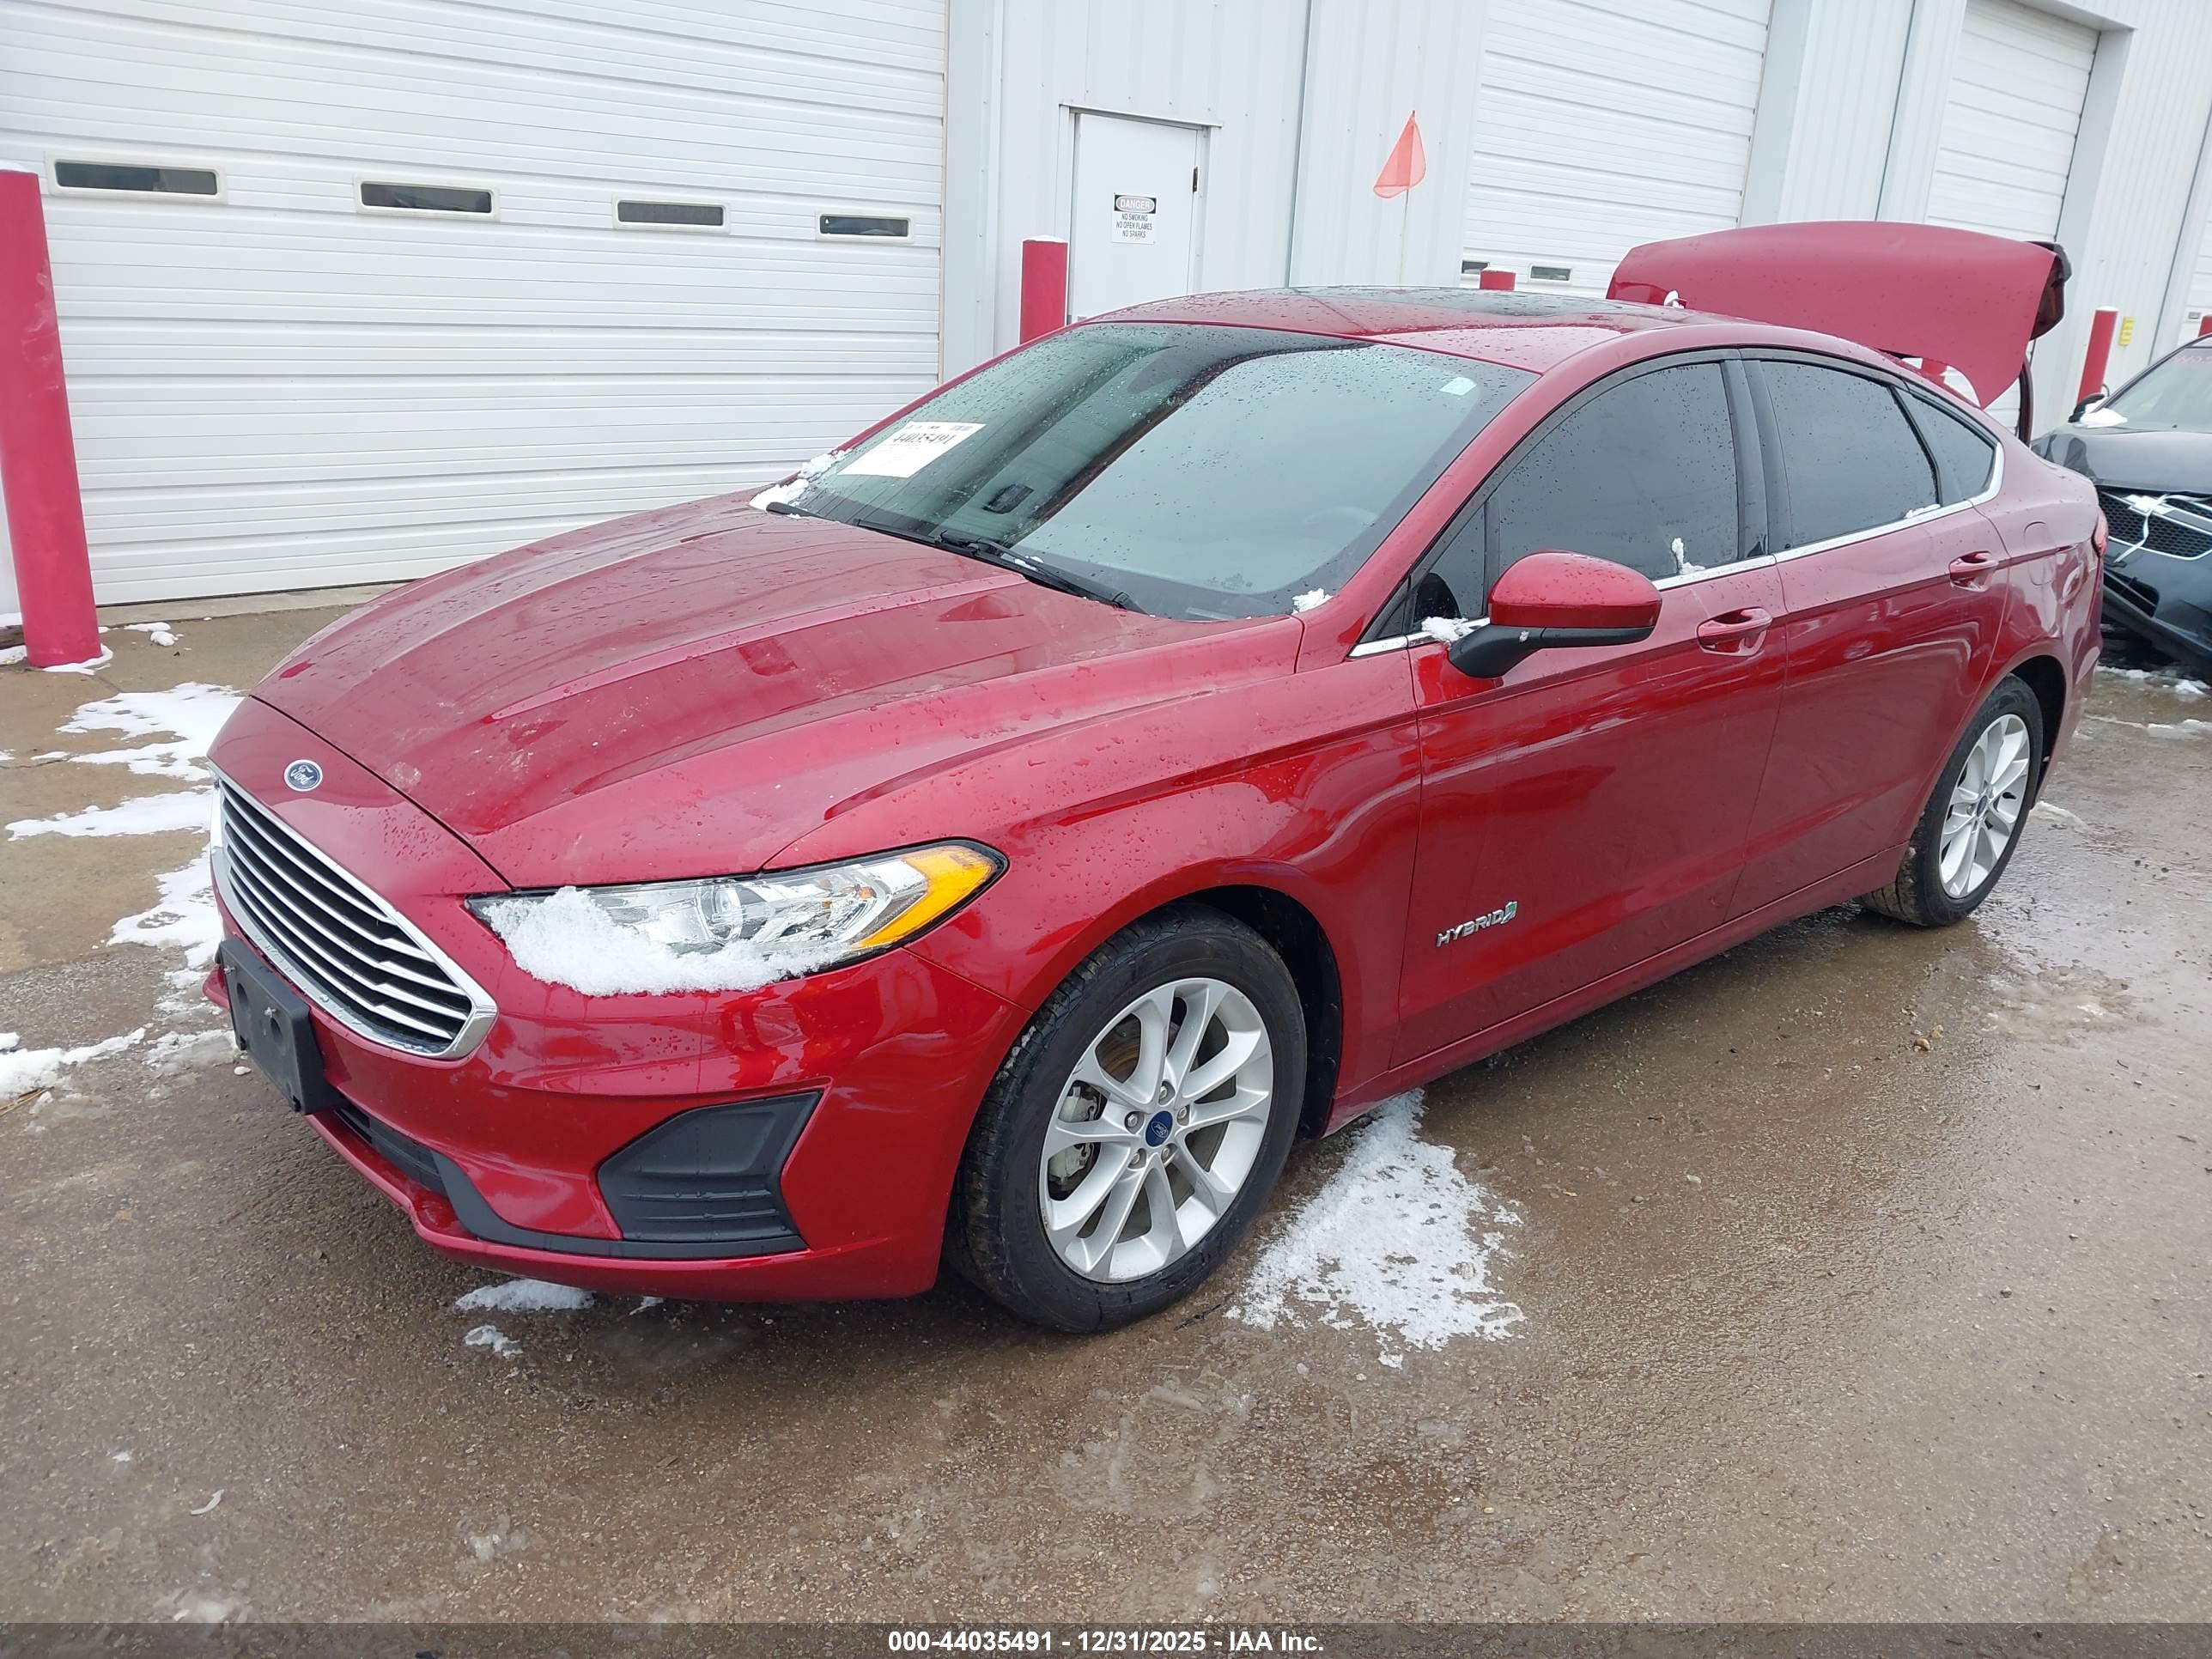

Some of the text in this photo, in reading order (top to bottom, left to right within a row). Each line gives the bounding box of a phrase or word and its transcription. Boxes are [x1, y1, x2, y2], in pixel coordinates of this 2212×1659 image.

[1120, 198, 1151, 210] DANGER
[1129, 213, 1148, 222] SMOKING
[1123, 221, 1135, 229] OPEN
[1136, 222, 1152, 230] FLAMES
[1129, 230, 1146, 239] SPARKS
[1436, 909, 1504, 947] HYBRID
